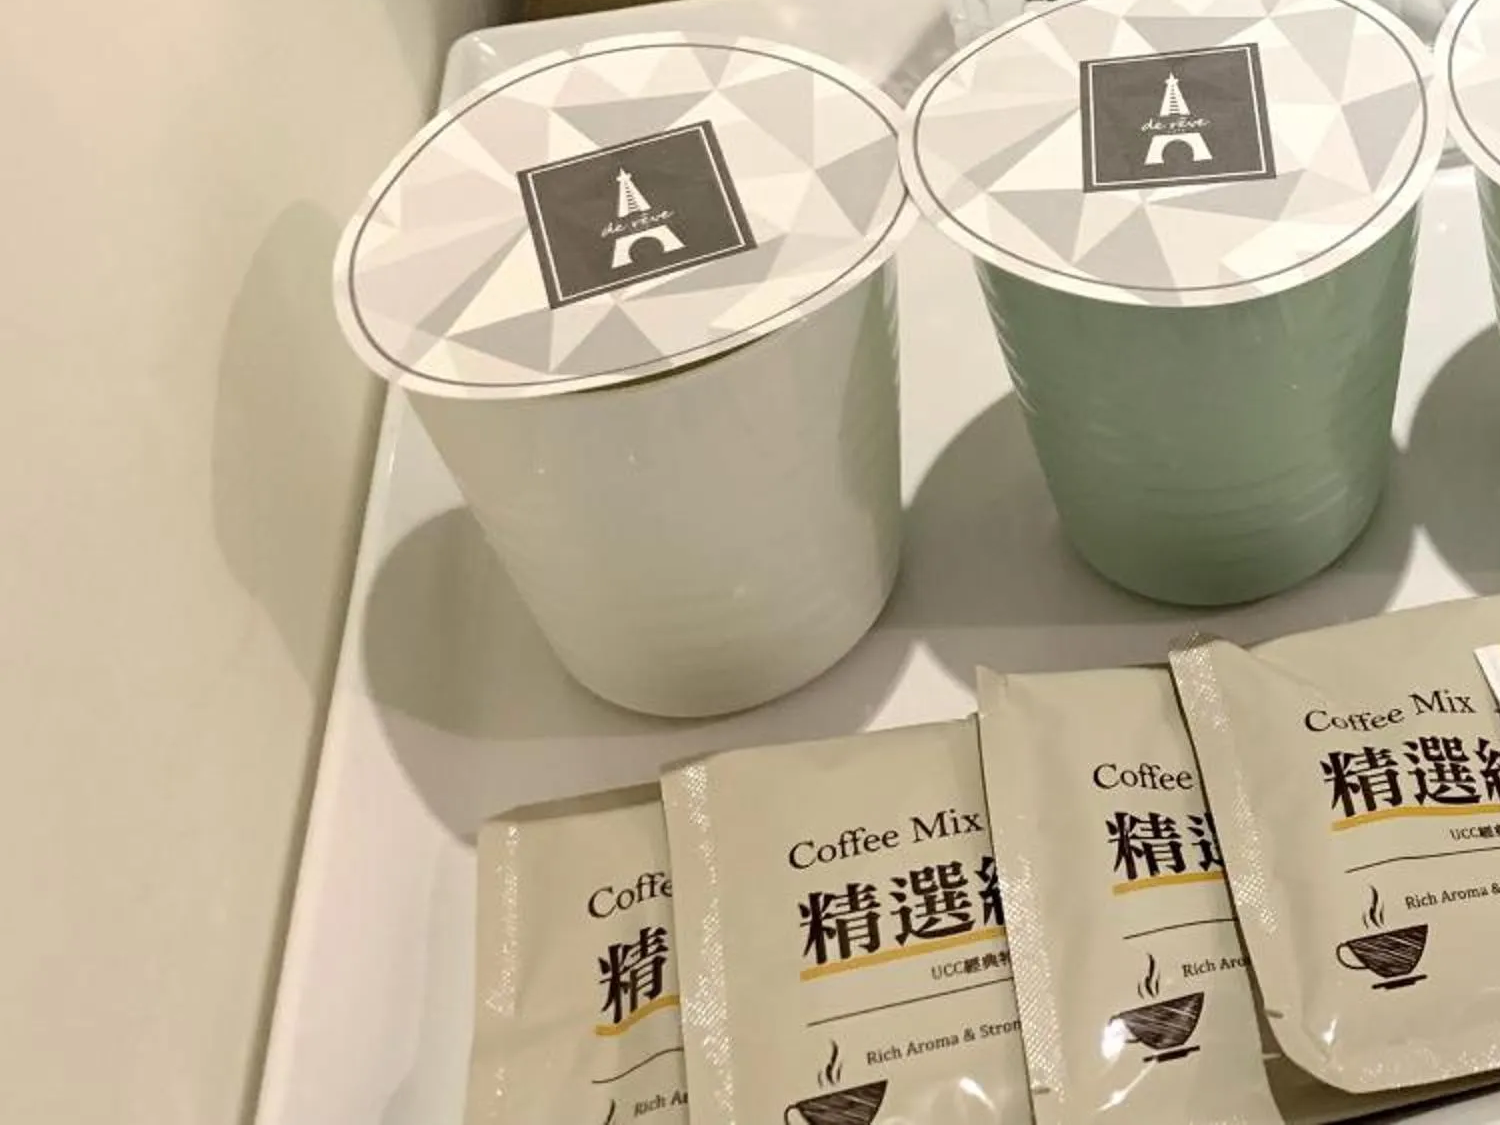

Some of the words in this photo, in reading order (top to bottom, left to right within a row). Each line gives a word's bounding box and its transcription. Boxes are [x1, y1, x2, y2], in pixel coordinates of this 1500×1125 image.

[1304, 707, 1405, 733] Coffee
[1408, 689, 1477, 716] Mix
[1093, 762, 1195, 791] Coffee
[788, 826, 900, 870] Coffee
[909, 808, 985, 844] Mix
[1404, 892, 1438, 910] Rich
[1441, 886, 1489, 904] Aroma
[598, 926, 669, 1024] 精
[1182, 958, 1217, 978] Rich
[866, 1045, 902, 1065] Rich
[906, 1033, 960, 1057] Aroma
[963, 1027, 976, 1042] &
